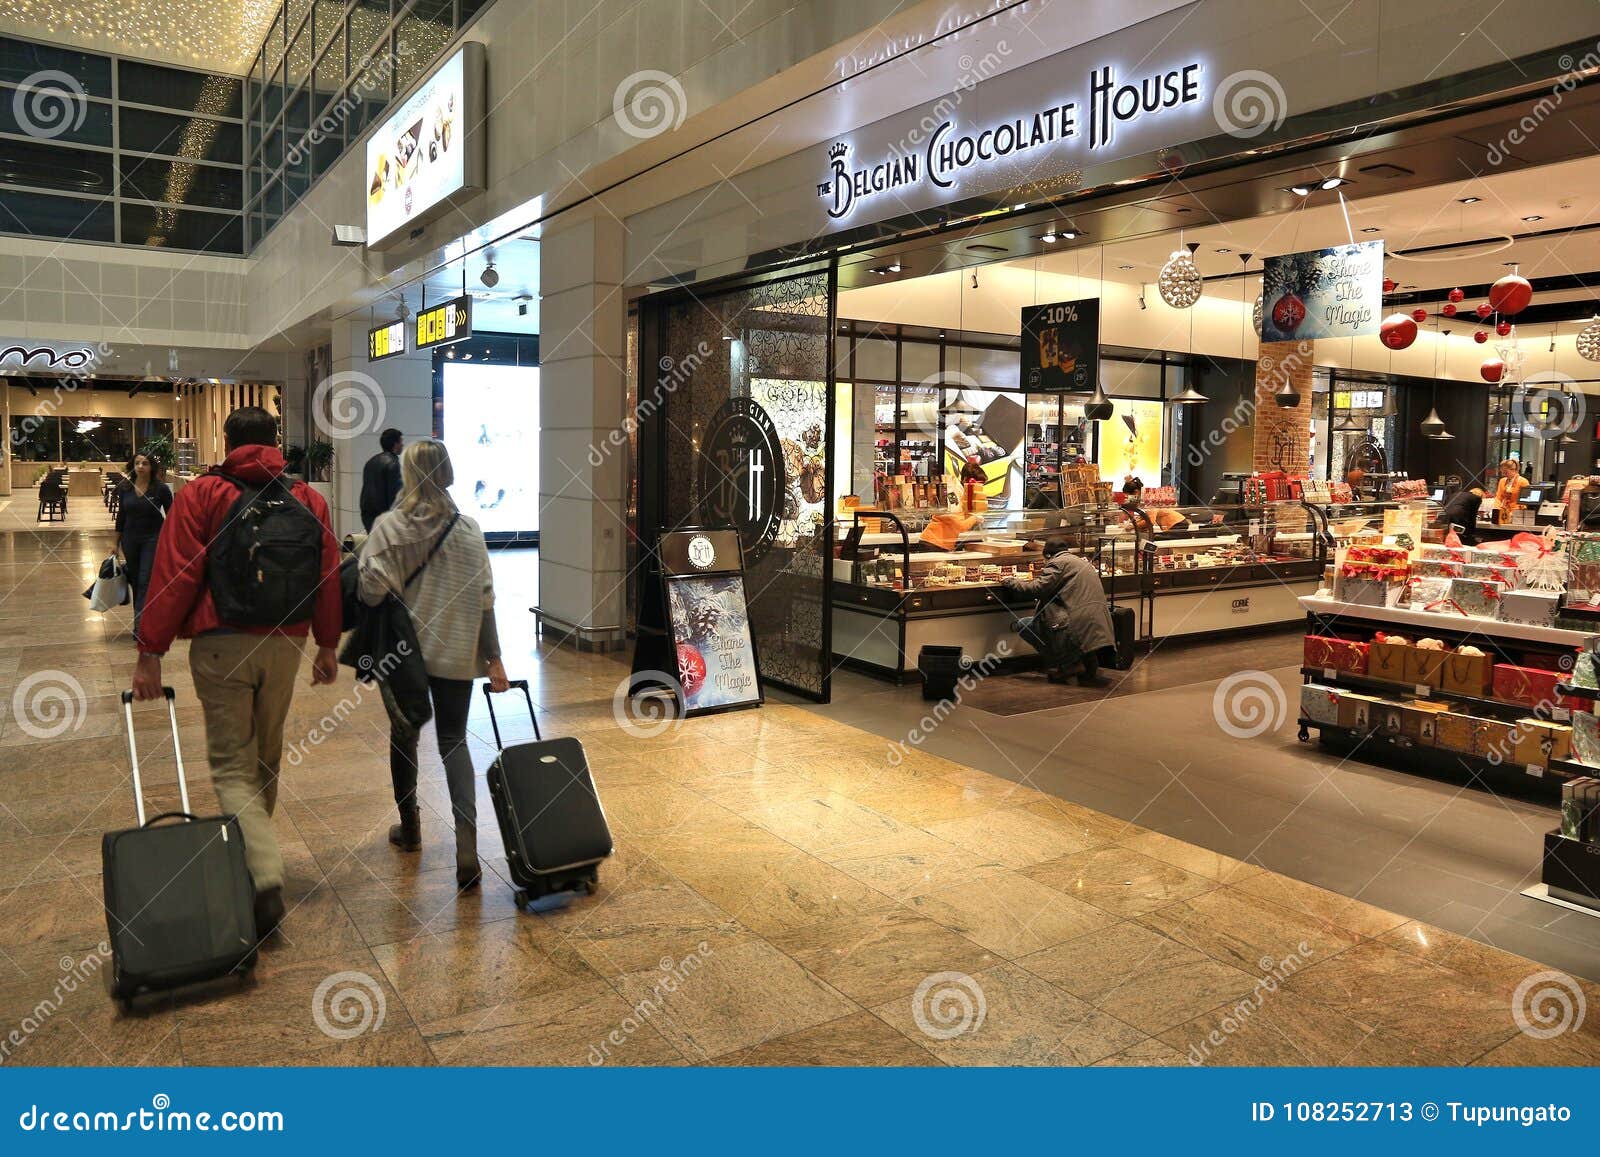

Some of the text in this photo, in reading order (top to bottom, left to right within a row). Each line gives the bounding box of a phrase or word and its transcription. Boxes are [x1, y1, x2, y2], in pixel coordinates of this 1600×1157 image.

[817, 64, 1198, 218] THE BELGIAN CHOCOLATE HOUSE
[1335, 281, 1363, 301] The
[1041, 305, 1078, 324] -10%
[1325, 304, 1372, 329] Magic
[719, 653, 742, 671] The
[714, 673, 752, 694] Magic
